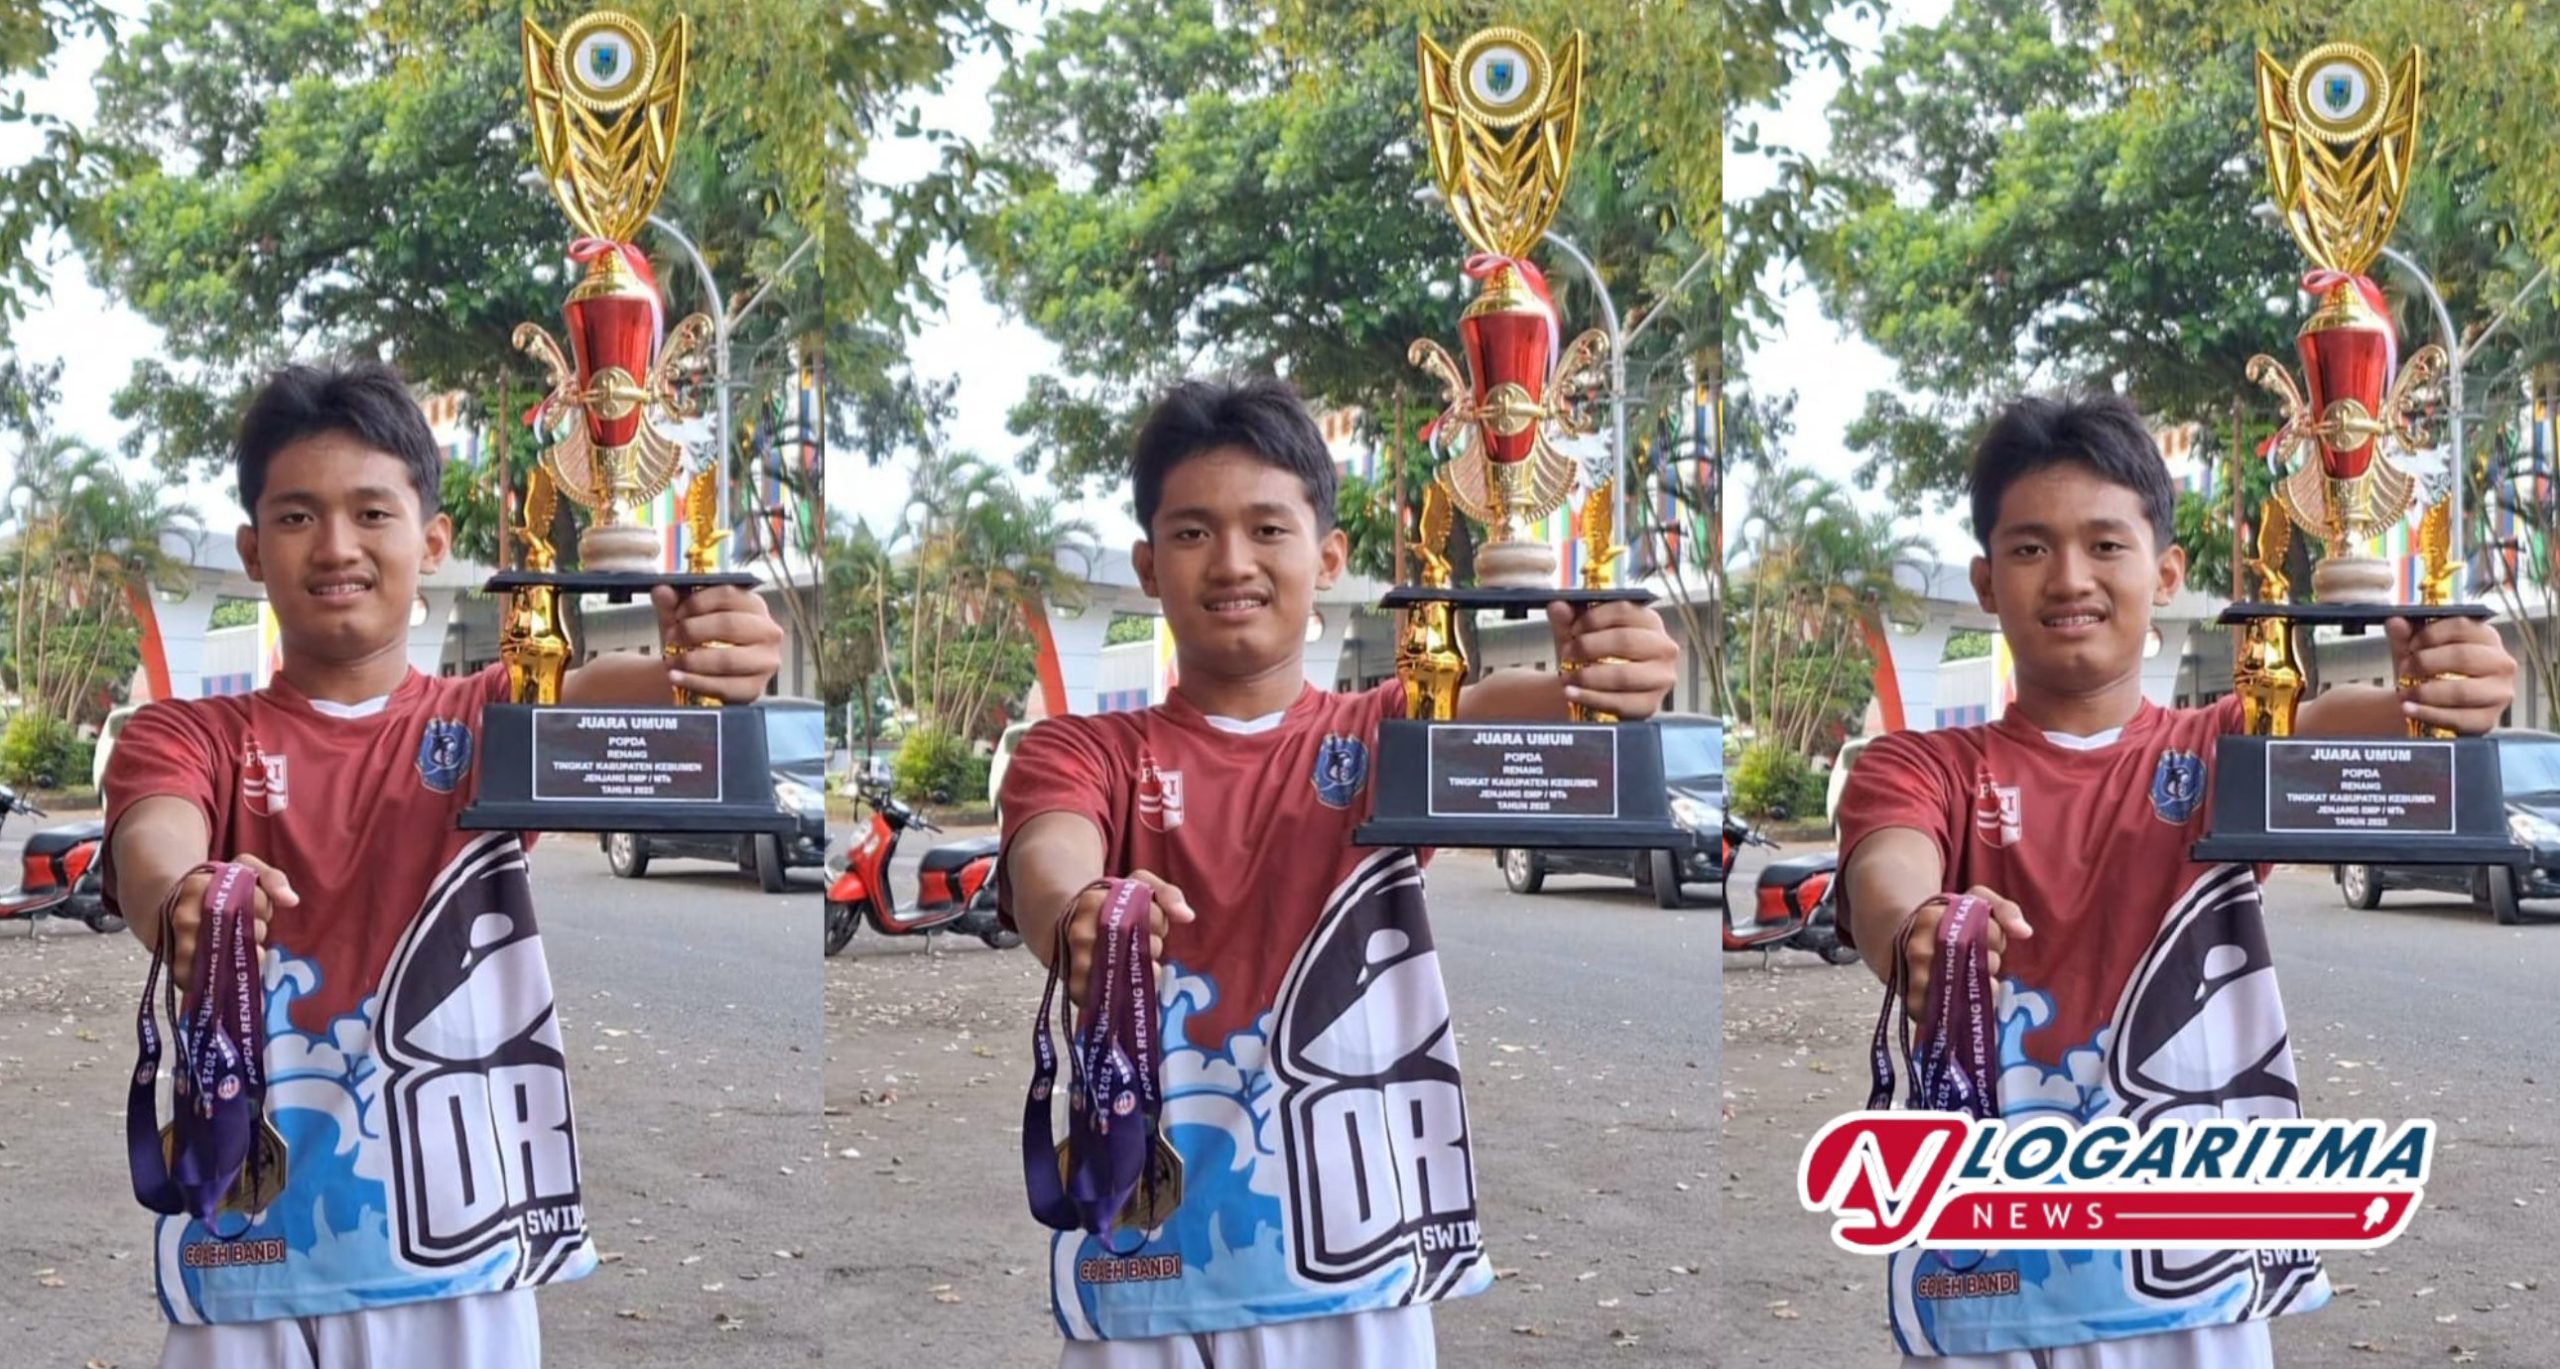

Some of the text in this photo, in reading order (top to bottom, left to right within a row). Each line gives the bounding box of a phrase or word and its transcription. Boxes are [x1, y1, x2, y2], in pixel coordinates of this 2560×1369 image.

[577, 716, 678, 730] JUARA UMUM
[608, 737, 646, 747] POPDA
[1473, 732, 1574, 746] JUARA UMUM
[607, 750, 647, 759] RENANG
[1504, 753, 1542, 763] POPDA
[2311, 748, 2412, 762] JUARA UMUM
[553, 761, 702, 772] TINGKAT KABUPATEN KEBUMEN
[1503, 766, 1543, 775] RENANG
[583, 774, 625, 783] JENJANG
[627, 774, 647, 783] SMP
[2342, 769, 2380, 779] POPDA
[1449, 777, 1598, 788] TINGKAT KABUPATEN KEBUMEN
[2341, 782, 2381, 791] RENANG
[601, 786, 632, 794] TAHUN
[1479, 790, 1521, 799] JENJANG
[1523, 790, 1543, 799] SMP
[2287, 793, 2436, 804] TINGKAT KABUPATEN KEBUMEN
[1497, 802, 1528, 810] TAHUN
[2317, 806, 2359, 815] JENJANG
[2361, 806, 2381, 815] SMP
[2335, 818, 2366, 826] TAHUN
[212, 891, 228, 949] TINGKAT
[1108, 907, 1124, 965] TINGKAT
[1946, 923, 1962, 981] TINGKAT
[237, 970, 253, 1033] RENANG
[1133, 986, 1149, 1049] RENANG
[1971, 1002, 1987, 1065] RENANG
[202, 1052, 217, 1084] 2025
[1098, 1068, 1113, 1100] 2025
[232, 1240, 285, 1264] BANDI
[1128, 1256, 1181, 1280] BANDI
[1966, 1272, 2019, 1296] BANDI
